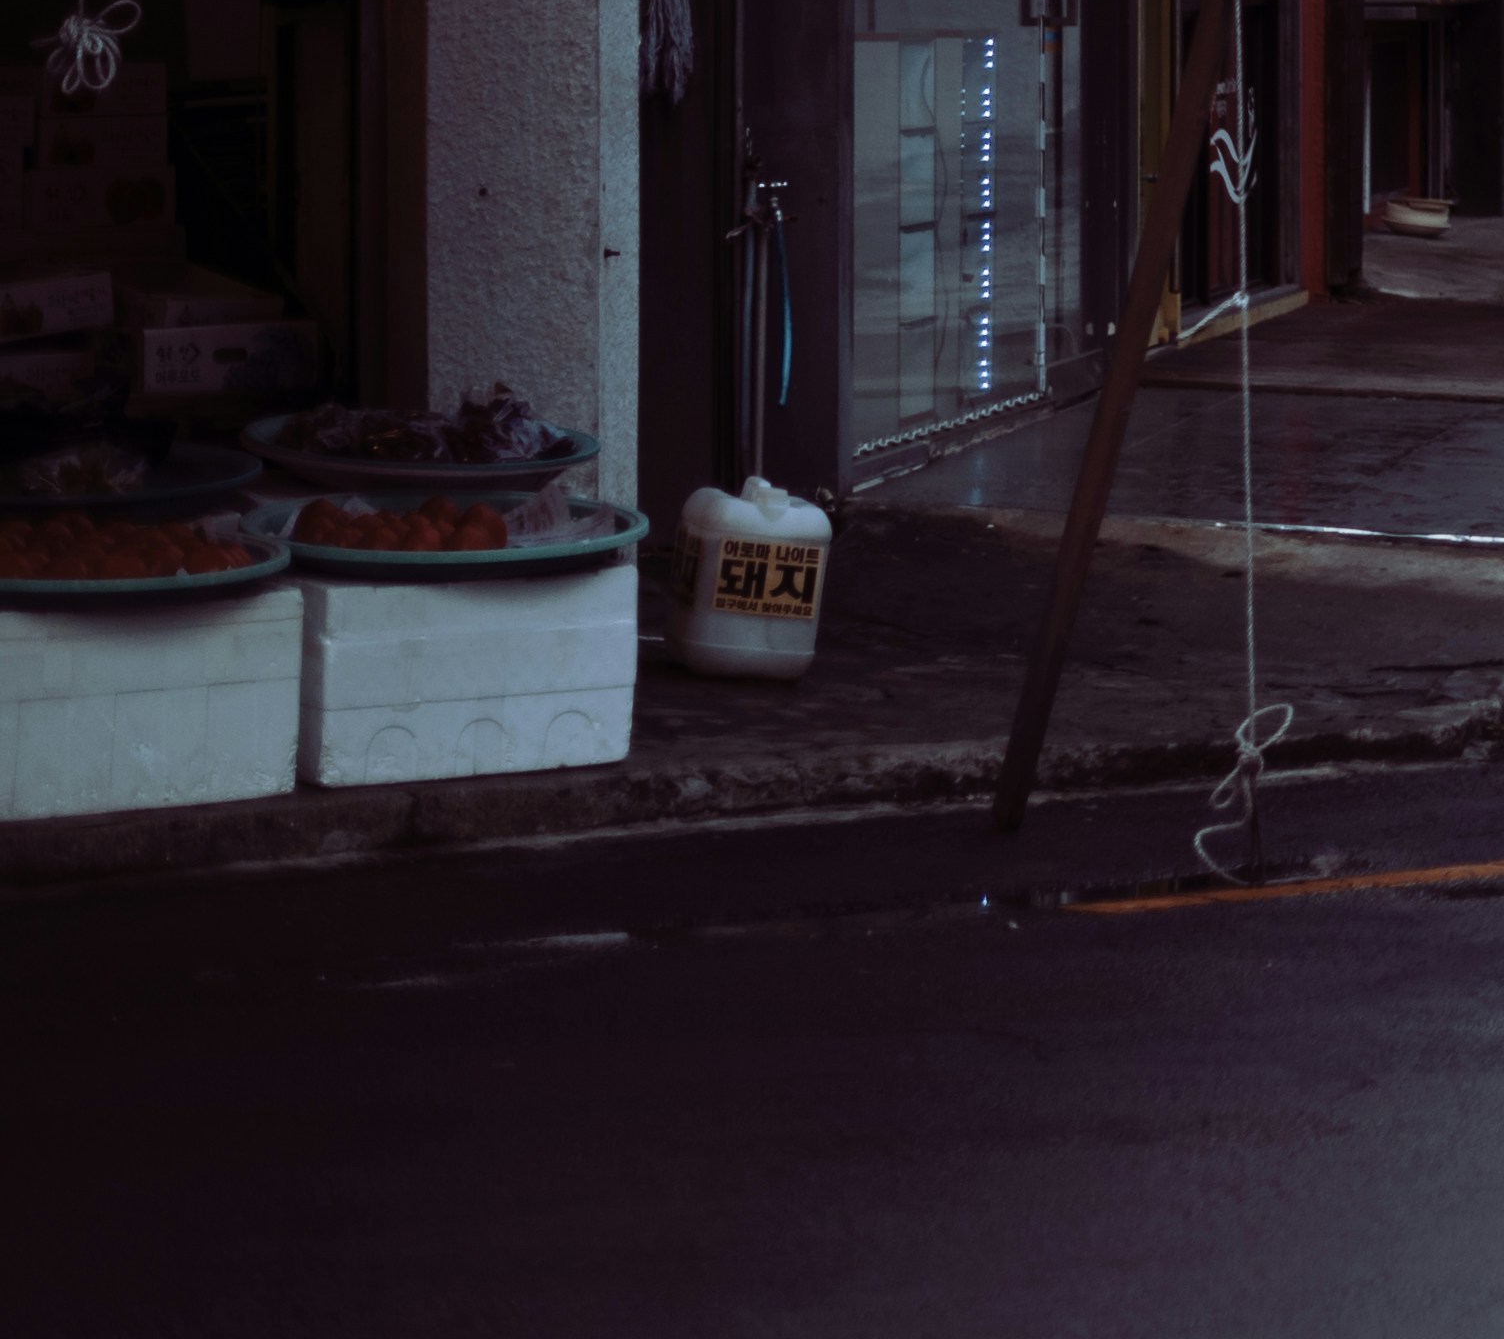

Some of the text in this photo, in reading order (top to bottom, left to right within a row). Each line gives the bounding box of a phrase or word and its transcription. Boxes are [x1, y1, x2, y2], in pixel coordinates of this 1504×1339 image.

[724, 539, 821, 565] 아로마 나이트
[716, 558, 818, 604] 돼지
